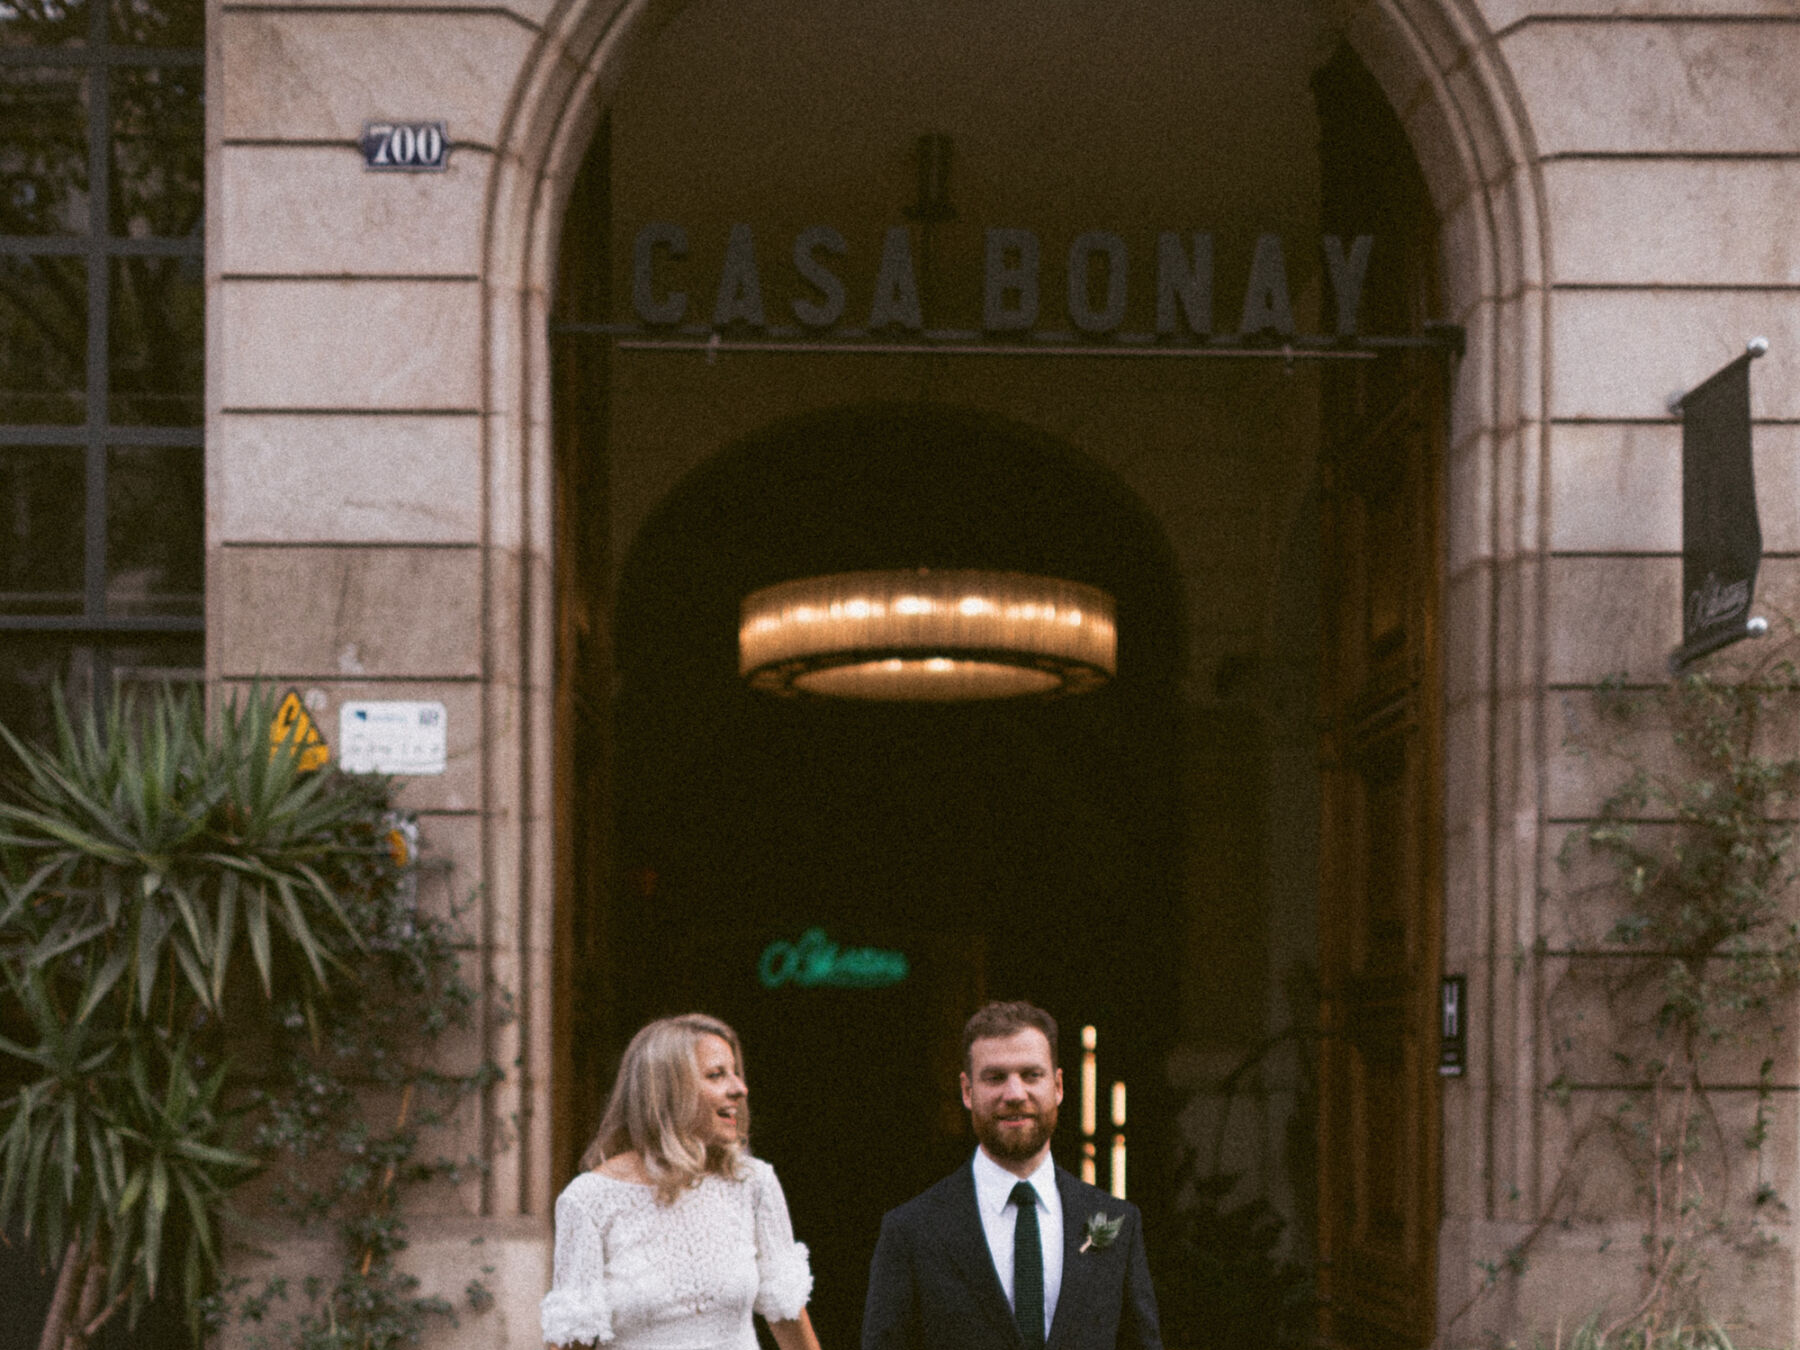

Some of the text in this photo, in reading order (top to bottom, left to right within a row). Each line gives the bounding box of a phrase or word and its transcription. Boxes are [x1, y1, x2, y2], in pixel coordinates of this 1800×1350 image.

[370, 126, 441, 164] 700
[633, 221, 1374, 335] CASA BONAY
